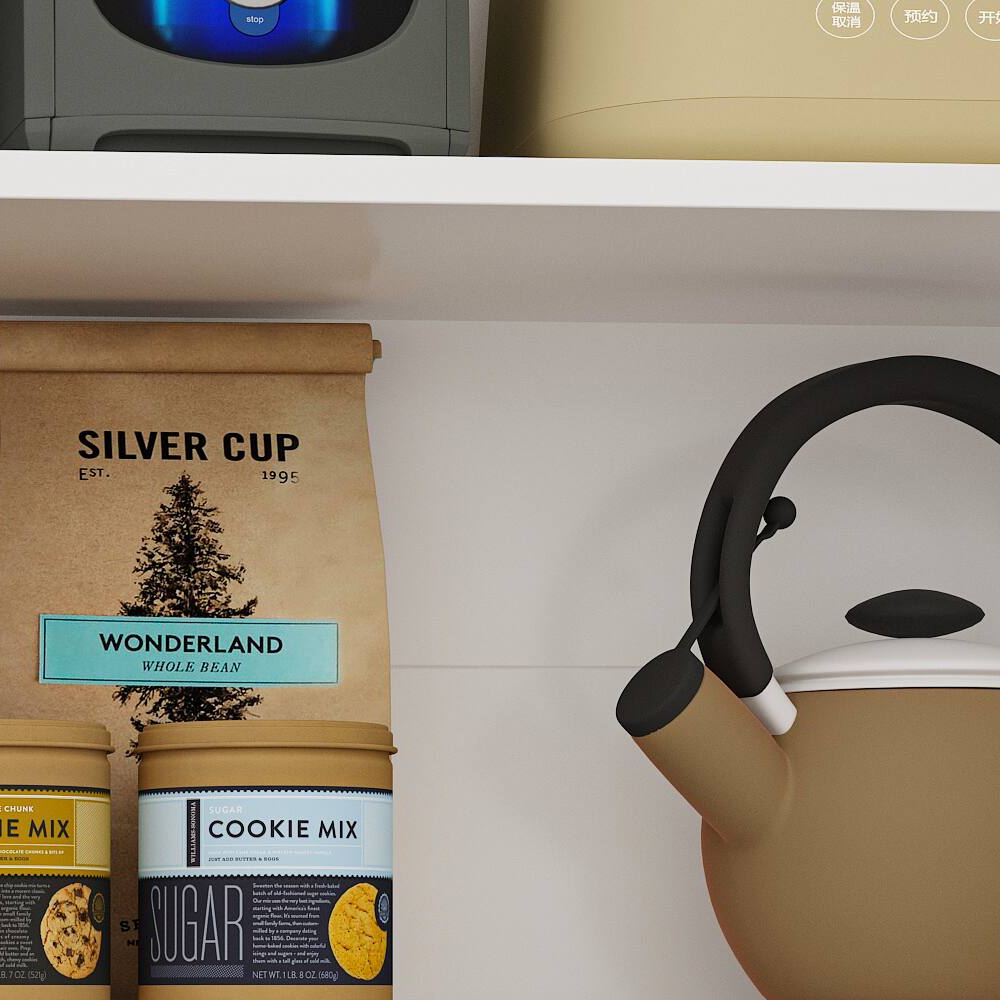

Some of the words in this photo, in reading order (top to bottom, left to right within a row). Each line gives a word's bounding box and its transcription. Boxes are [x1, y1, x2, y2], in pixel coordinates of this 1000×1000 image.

[831, 1, 861, 14] 保温
[246, 15, 264, 25] stop
[831, 15, 861, 29] 取消
[903, 9, 938, 24] 预约
[77, 429, 208, 461] SILVER
[222, 432, 300, 463] CUP
[78, 467, 111, 481] EST.
[261, 470, 300, 485] 1995
[98, 633, 284, 655] WONDERLAND
[141, 659, 194, 674] WHOLE
[198, 660, 242, 674] BEAN
[4, 805, 34, 813] CHUNK
[208, 806, 243, 814] SUGAR
[28, 819, 70, 839] MIX
[208, 819, 310, 839] COOKIE
[318, 820, 357, 839] MIX
[150, 884, 245, 961] SUGAR
[14, 971, 26, 979] OZ.
[253, 971, 268, 979] NET
[269, 971, 281, 979] WT.
[288, 971, 297, 979] LB.
[305, 971, 316, 979] OZ.
[319, 971, 338, 981] (680g)
